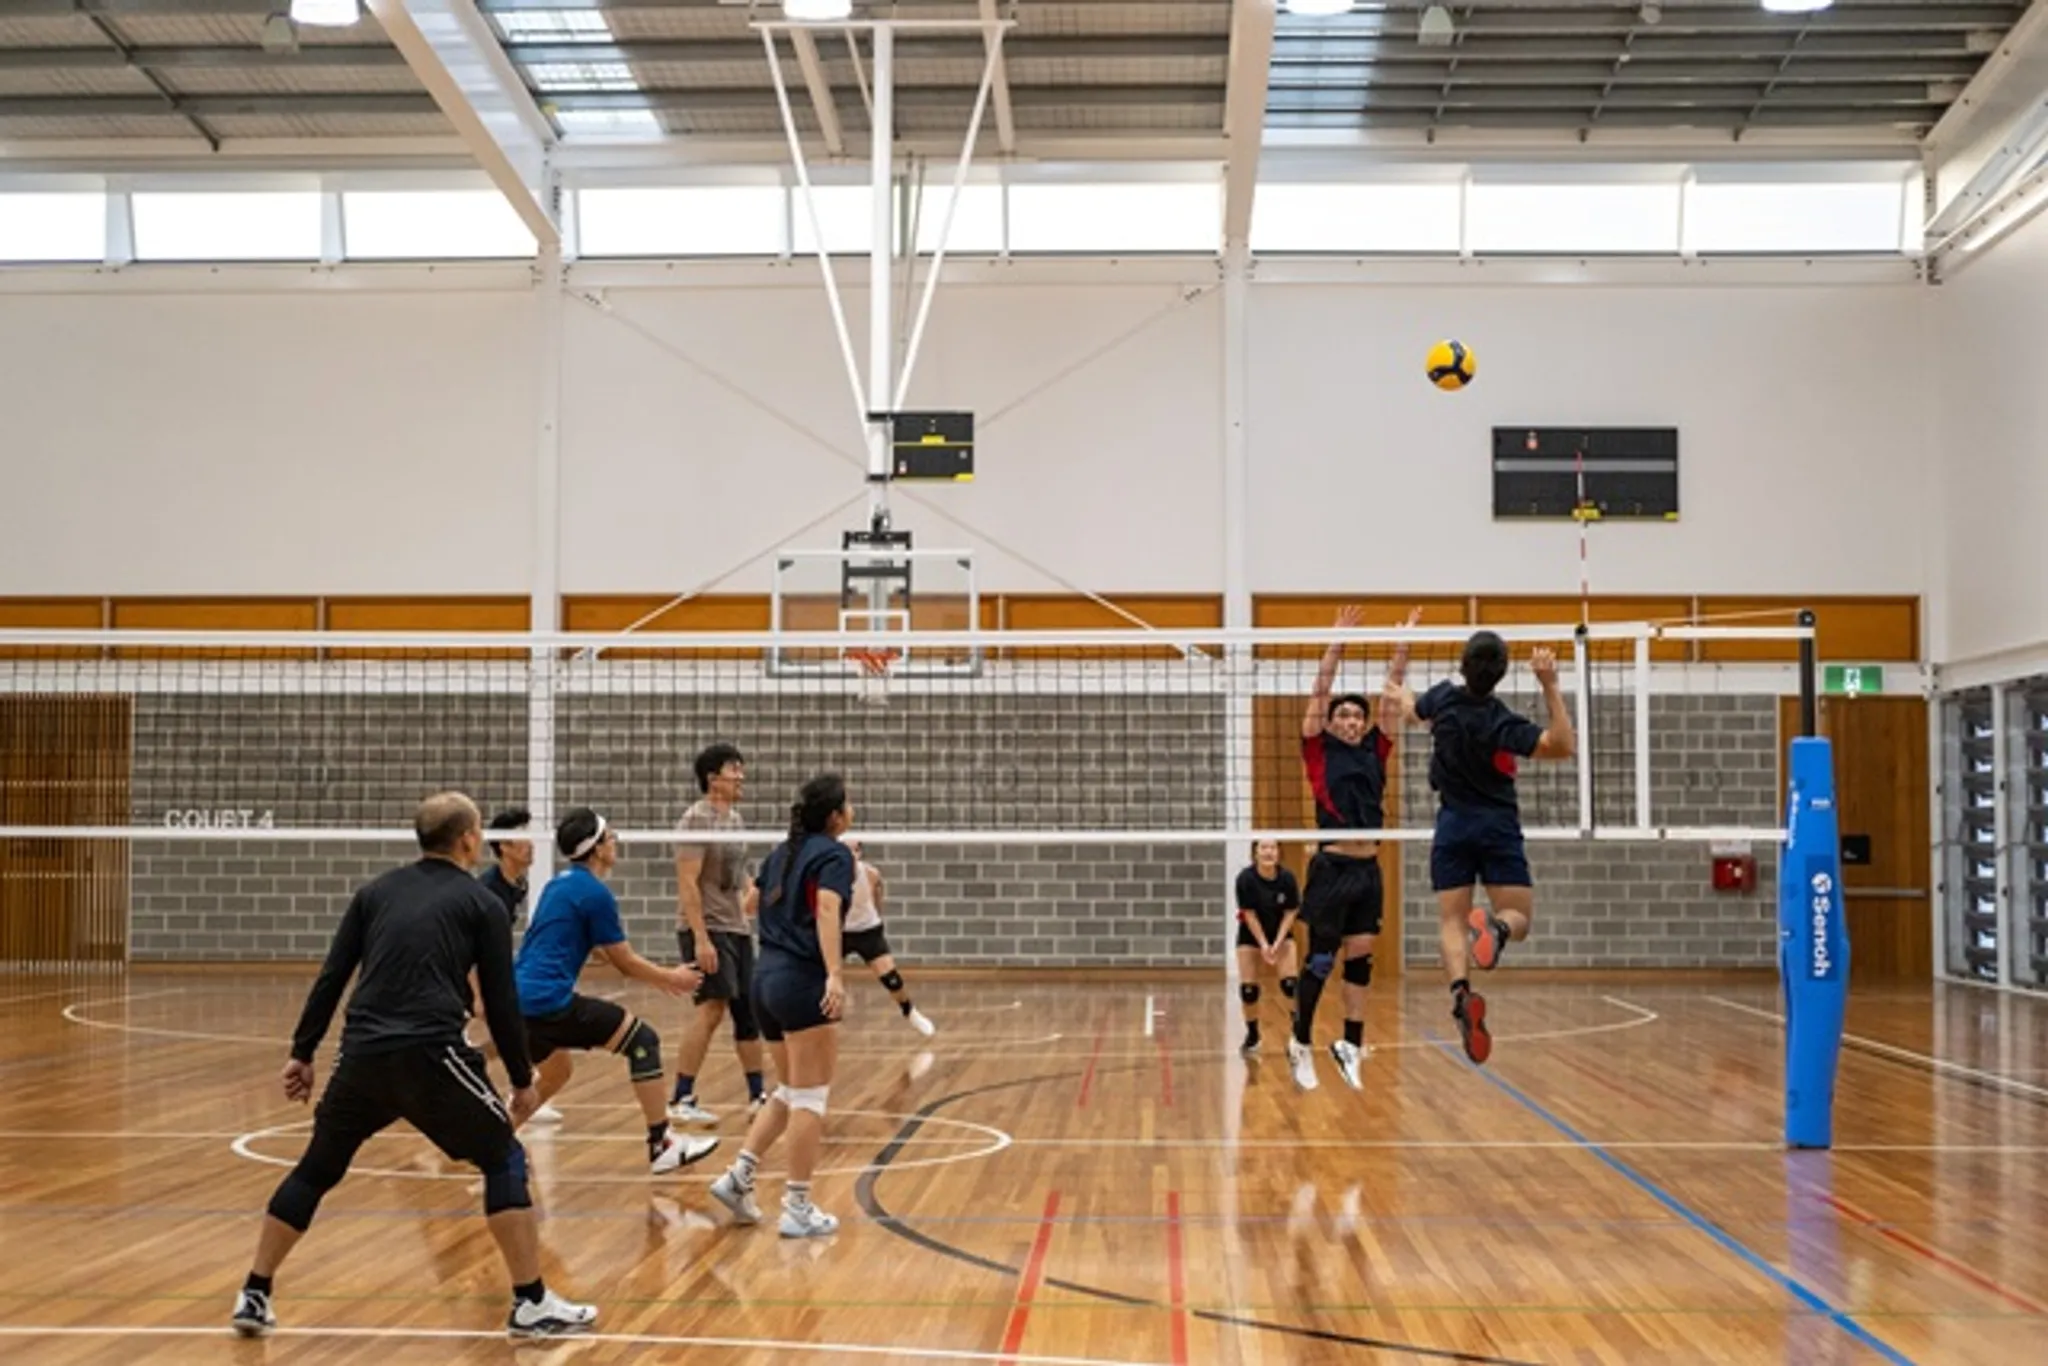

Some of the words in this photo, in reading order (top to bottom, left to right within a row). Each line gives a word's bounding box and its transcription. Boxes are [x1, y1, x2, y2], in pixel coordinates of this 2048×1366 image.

[164, 808, 254, 830] COURT
[260, 808, 274, 830] 4
[1812, 895, 1832, 978] Senoh
